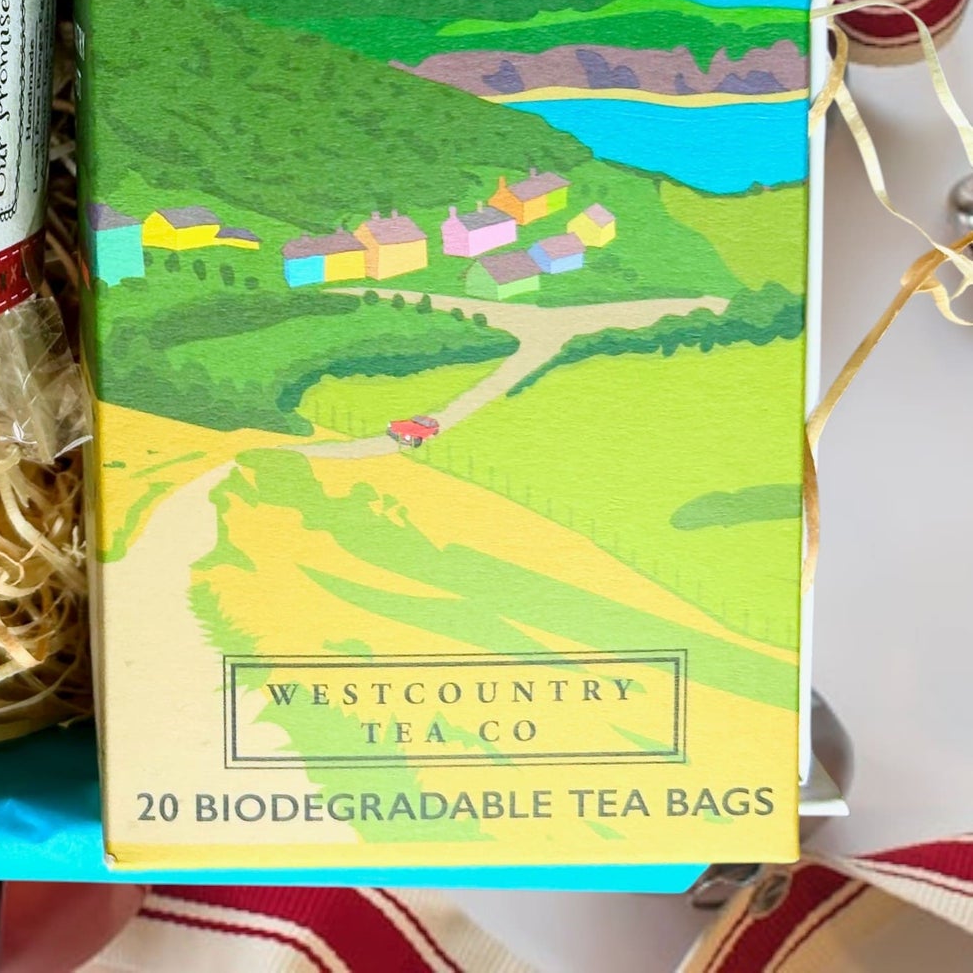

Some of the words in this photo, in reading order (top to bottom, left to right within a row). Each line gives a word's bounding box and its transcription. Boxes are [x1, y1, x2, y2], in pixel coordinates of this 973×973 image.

[266, 677, 636, 708] WESTCOUNTRY
[360, 720, 449, 746] TEA
[479, 718, 539, 744] CO
[135, 792, 179, 823] 20
[194, 788, 553, 824] BIODEGRADABLE
[567, 787, 651, 818] TEA
[665, 785, 776, 817] BAGS
